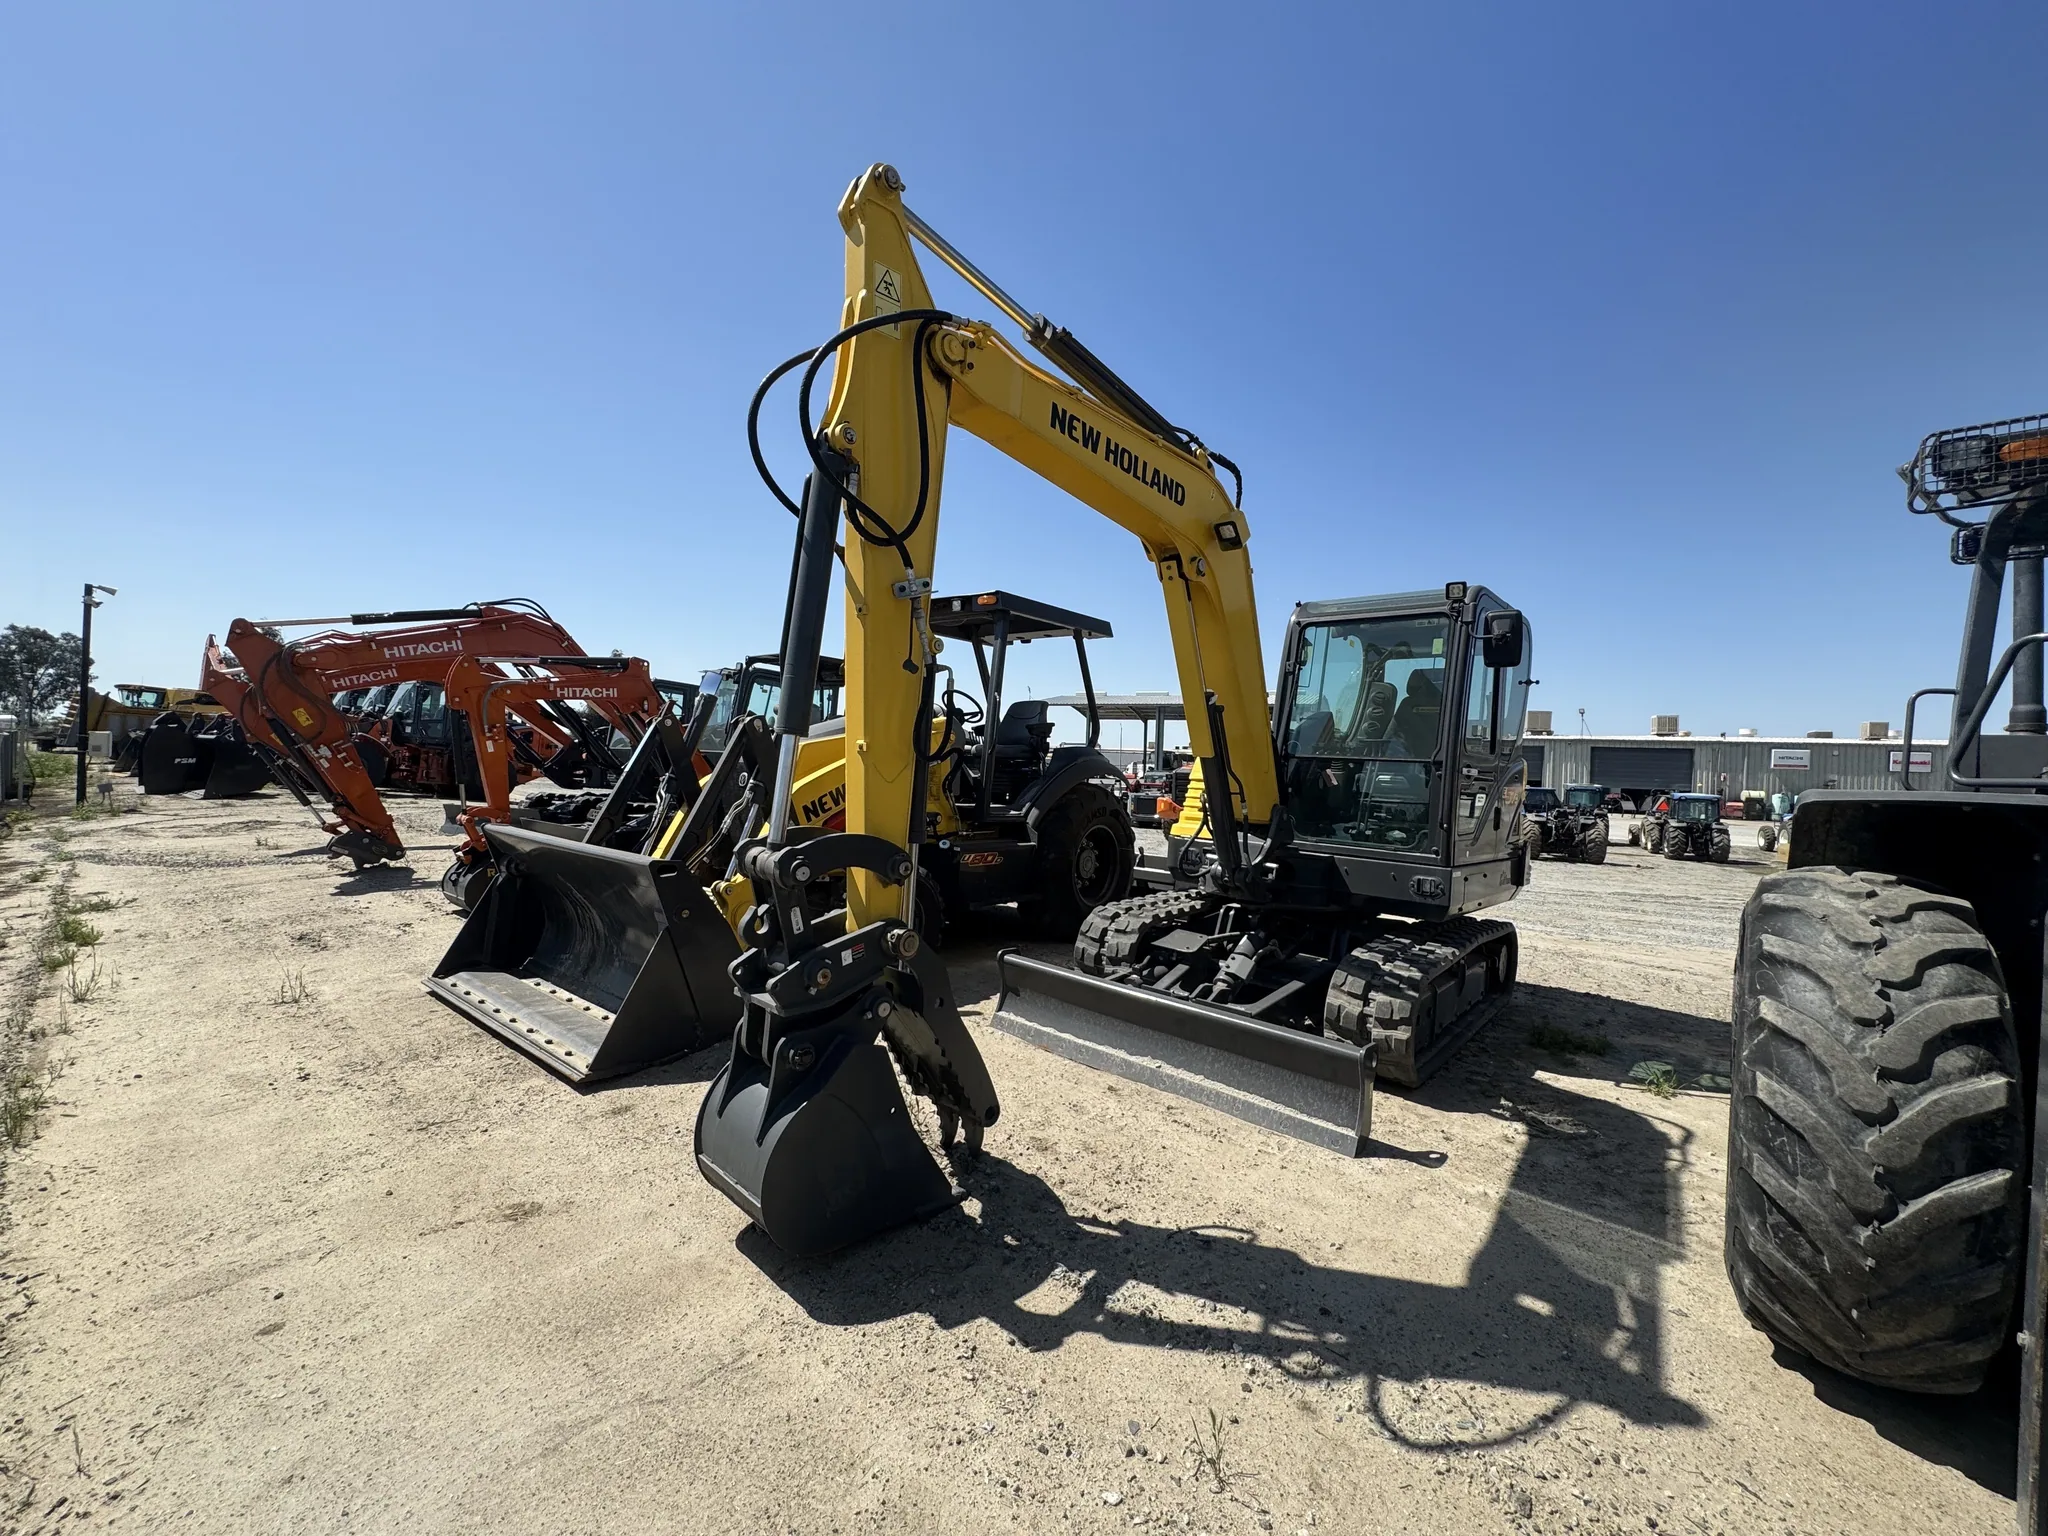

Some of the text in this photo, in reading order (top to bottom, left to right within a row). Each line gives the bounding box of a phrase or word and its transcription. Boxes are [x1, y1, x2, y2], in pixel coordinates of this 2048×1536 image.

[1050, 401, 1186, 507] NEW HOLLAND
[384, 639, 464, 659] HITACHI
[332, 668, 399, 689] HITACHI
[556, 687, 618, 698] HITACHI
[802, 782, 846, 823] NEW
